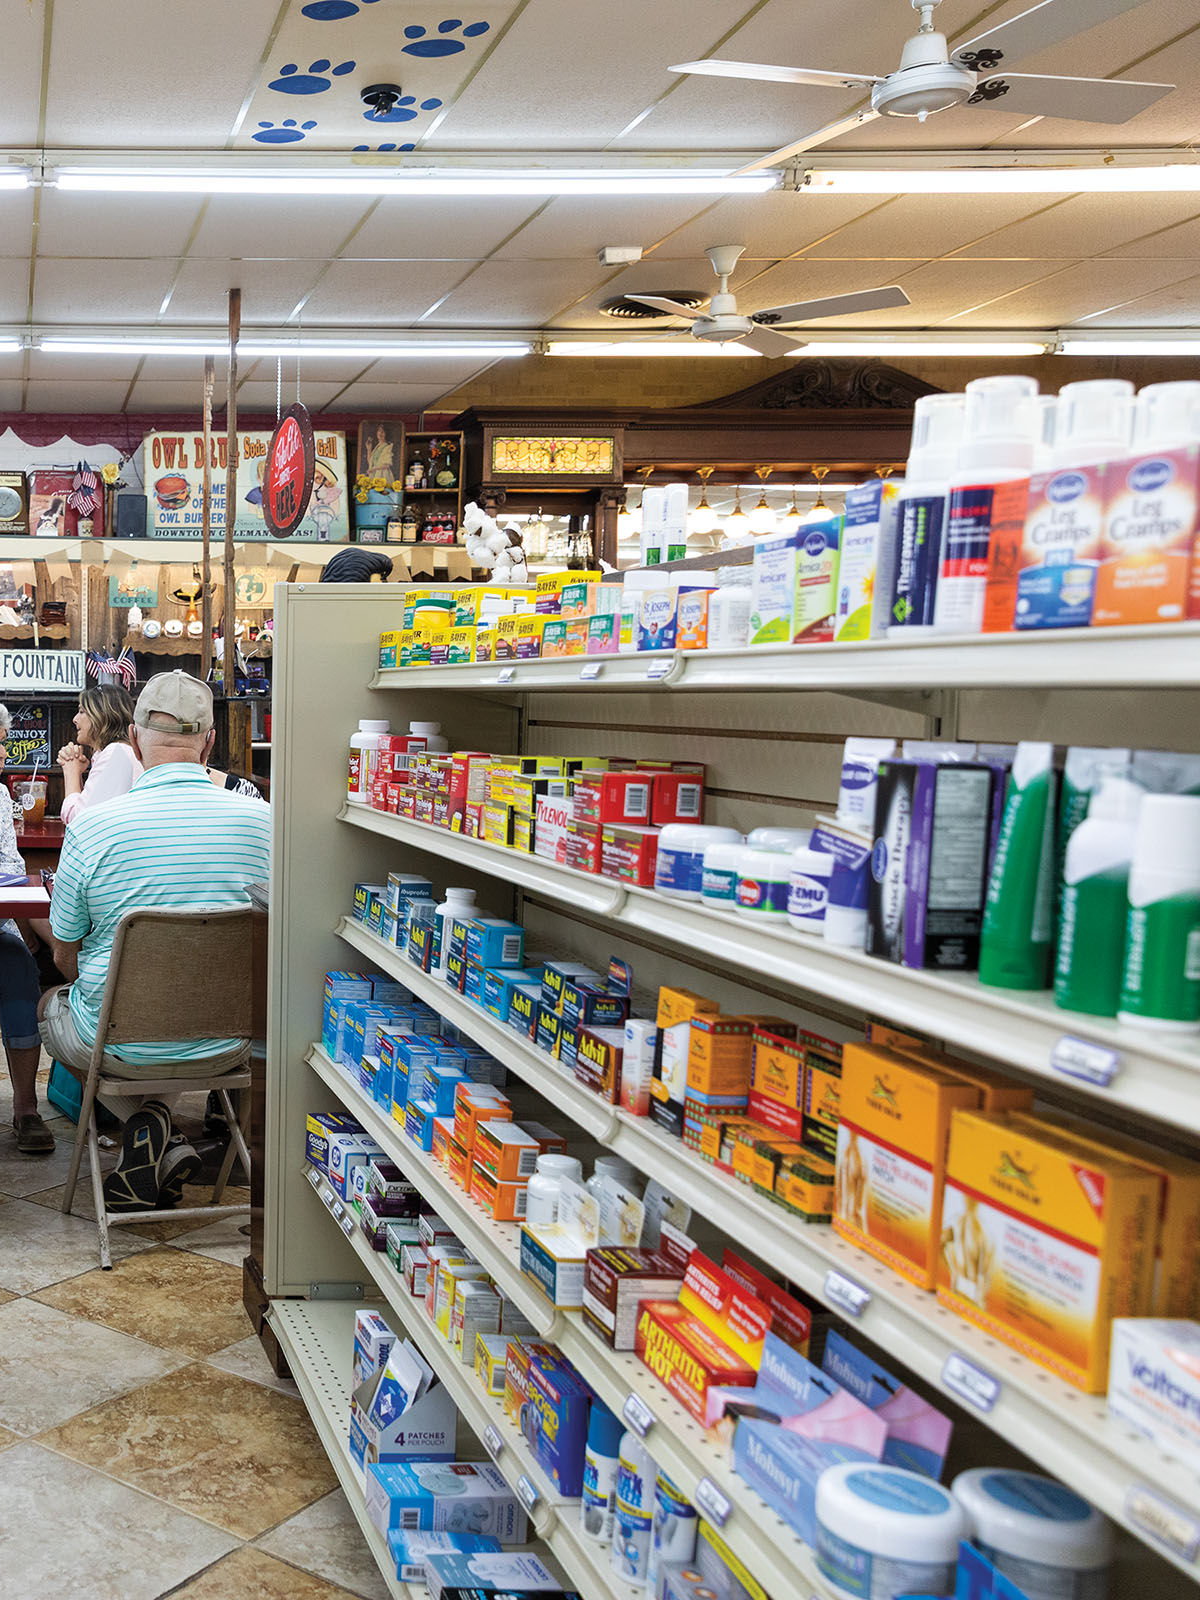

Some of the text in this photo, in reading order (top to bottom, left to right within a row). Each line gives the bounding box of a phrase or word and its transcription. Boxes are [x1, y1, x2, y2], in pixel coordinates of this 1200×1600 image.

[152, 437, 188, 469] OWL
[243, 435, 267, 460] Soda
[316, 436, 338, 460] Grill
[198, 483, 226, 494] HME
[275, 479, 296, 523] HERE
[1131, 499, 1163, 520] Leg
[159, 512, 181, 524] OWL
[1050, 507, 1077, 527] Leg
[220, 529, 271, 538] CLEMAN,
[1031, 524, 1093, 547] Cramps
[1109, 518, 1183, 541] Cramps
[536, 581, 557, 592] BAYER
[113, 596, 153, 604] COFFEE
[498, 621, 515, 633] BAYER
[519, 623, 535, 634] BAYER
[450, 632, 467, 642] BAYER
[3, 654, 80, 687] FOUNTAIN
[7, 729, 47, 739] ENJOY
[536, 799, 568, 829] TYLENOL
[355, 887, 367, 905] Advil
[400, 888, 430, 896] Ibuprofen
[371, 901, 382, 917] Advil
[411, 924, 426, 949] Advil
[453, 924, 467, 941] Advil
[448, 957, 462, 975] Advil
[543, 968, 562, 991] Advil
[511, 992, 532, 1018] Advil
[564, 988, 578, 1005] Advil
[595, 1003, 616, 1011] Advil
[539, 1011, 558, 1034] Advil
[562, 1029, 575, 1045] Advil
[380, 1050, 392, 1067] ALEVE
[578, 1033, 606, 1067] Advil
[397, 1057, 409, 1076] ALEVE
[308, 1133, 329, 1150] Goody's
[332, 1148, 341, 1167] BC
[686, 1263, 721, 1297] ARTHRITIS
[684, 1272, 724, 1311] PAIN RELIEF
[638, 1310, 707, 1391] ARTHRITIS
[644, 1339, 673, 1384] HOT
[394, 1431, 406, 1446] 4
[407, 1432, 446, 1440] PATCHES
